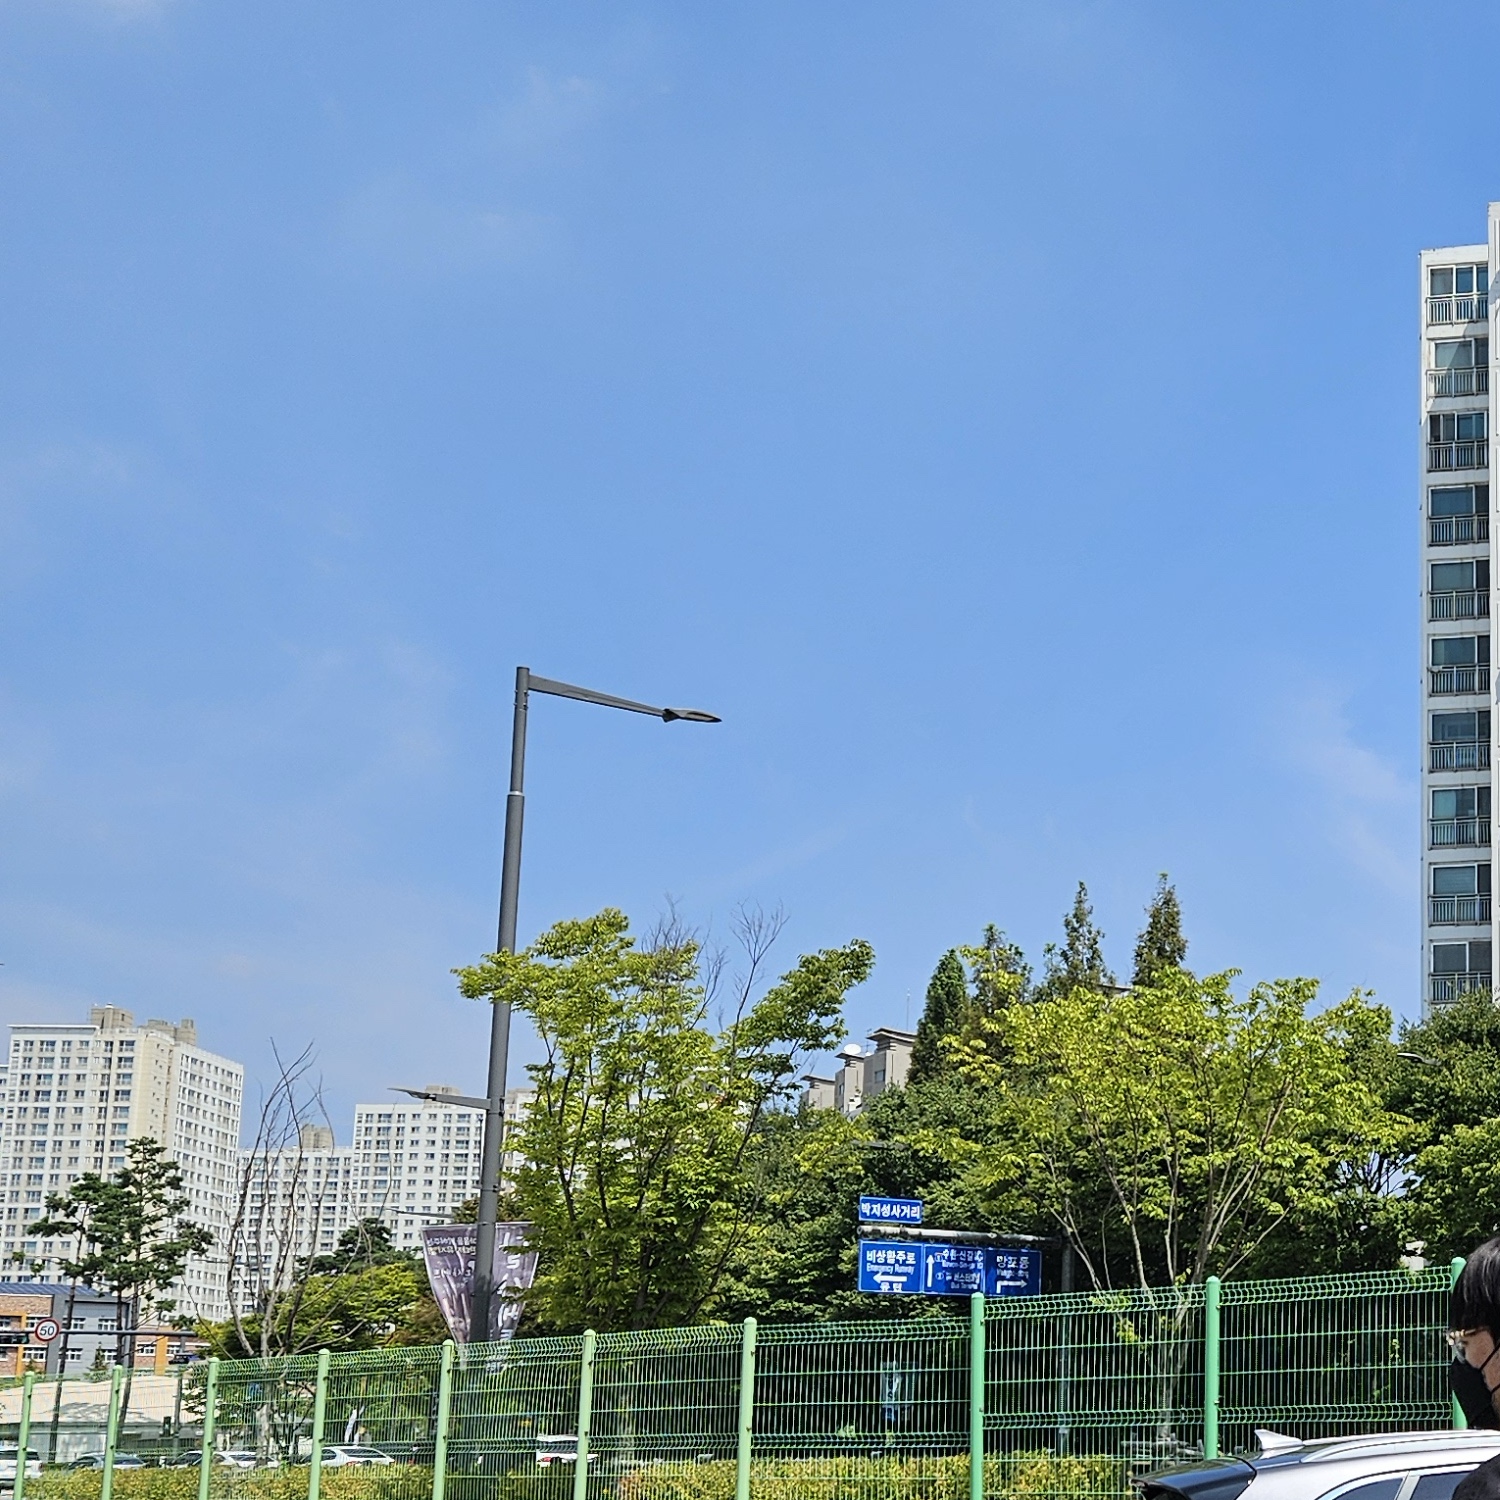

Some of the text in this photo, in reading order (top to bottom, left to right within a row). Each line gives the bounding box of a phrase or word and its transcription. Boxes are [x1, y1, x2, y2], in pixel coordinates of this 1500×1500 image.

[861, 1202, 920, 1219] 박지성사거리
[866, 1250, 916, 1264] 비상활주로
[40, 1325, 55, 1336] 50
